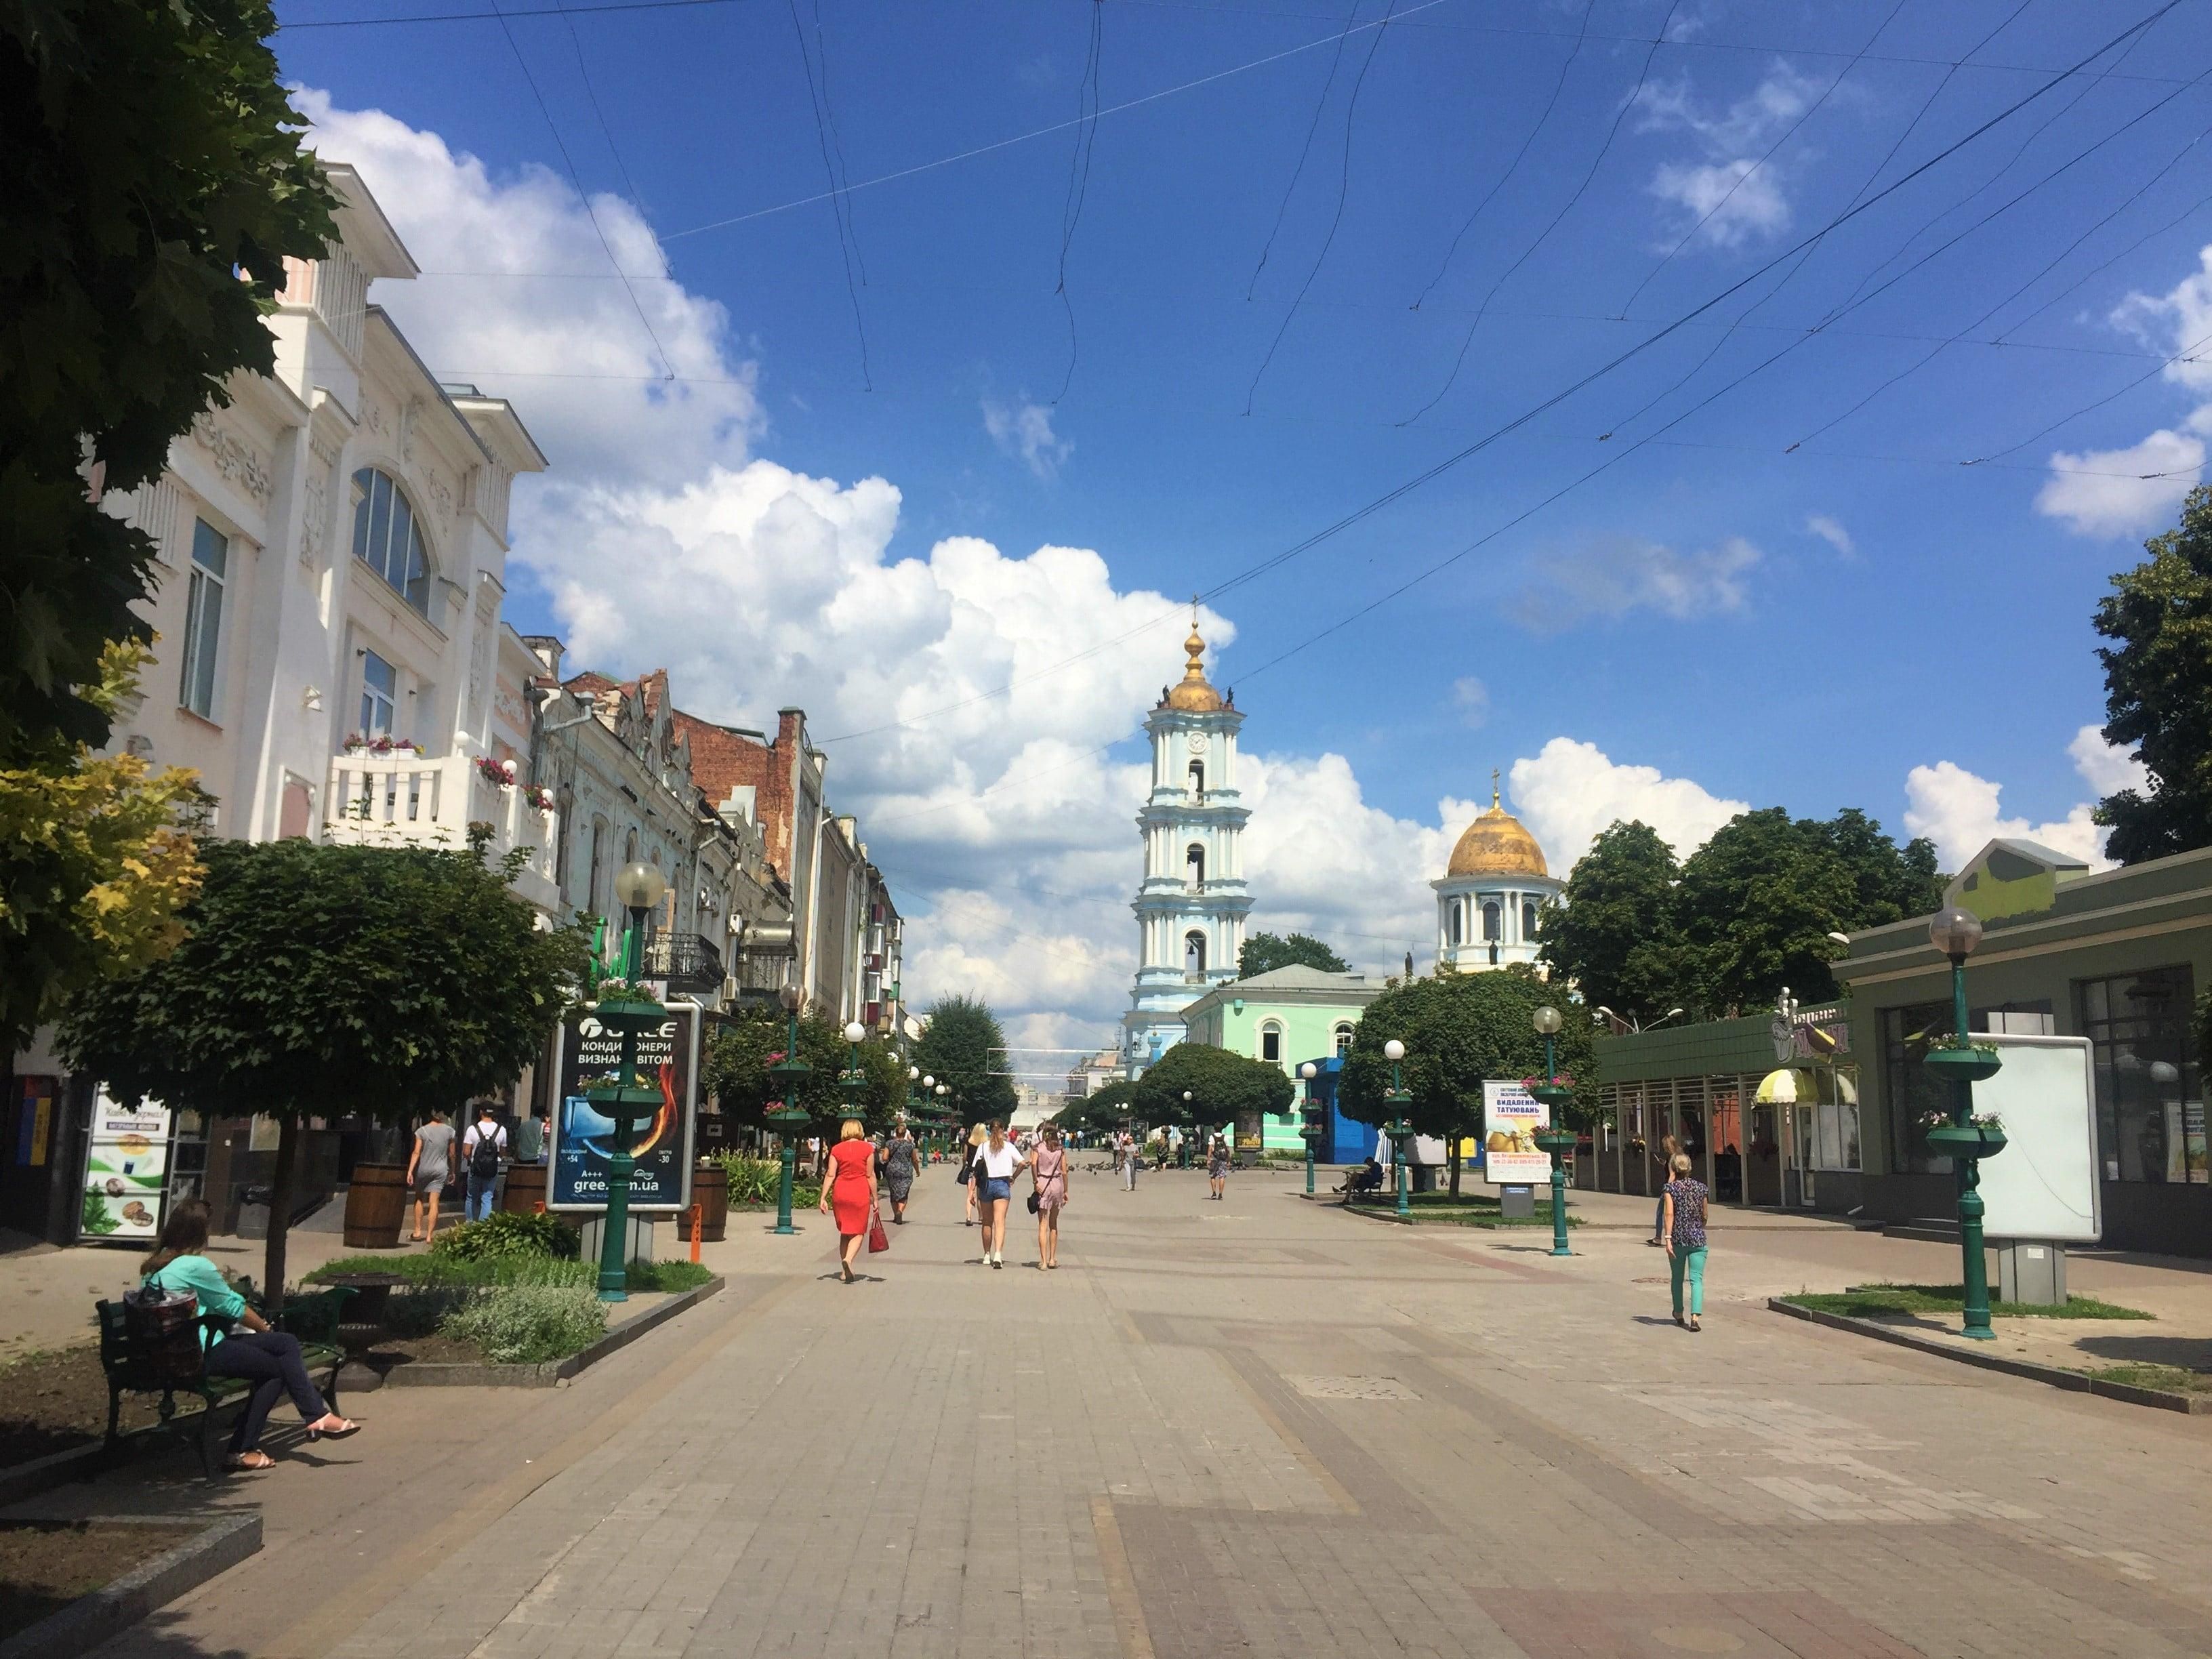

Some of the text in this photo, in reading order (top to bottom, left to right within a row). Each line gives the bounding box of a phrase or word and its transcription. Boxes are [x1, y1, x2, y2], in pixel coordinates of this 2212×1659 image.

[581, 1042, 672, 1053] КОНДИОНЕРИ
[636, 1054, 673, 1065] ВІТОМ
[658, 1155, 670, 1164] -30
[573, 1181, 659, 1193] gree.m.ua
